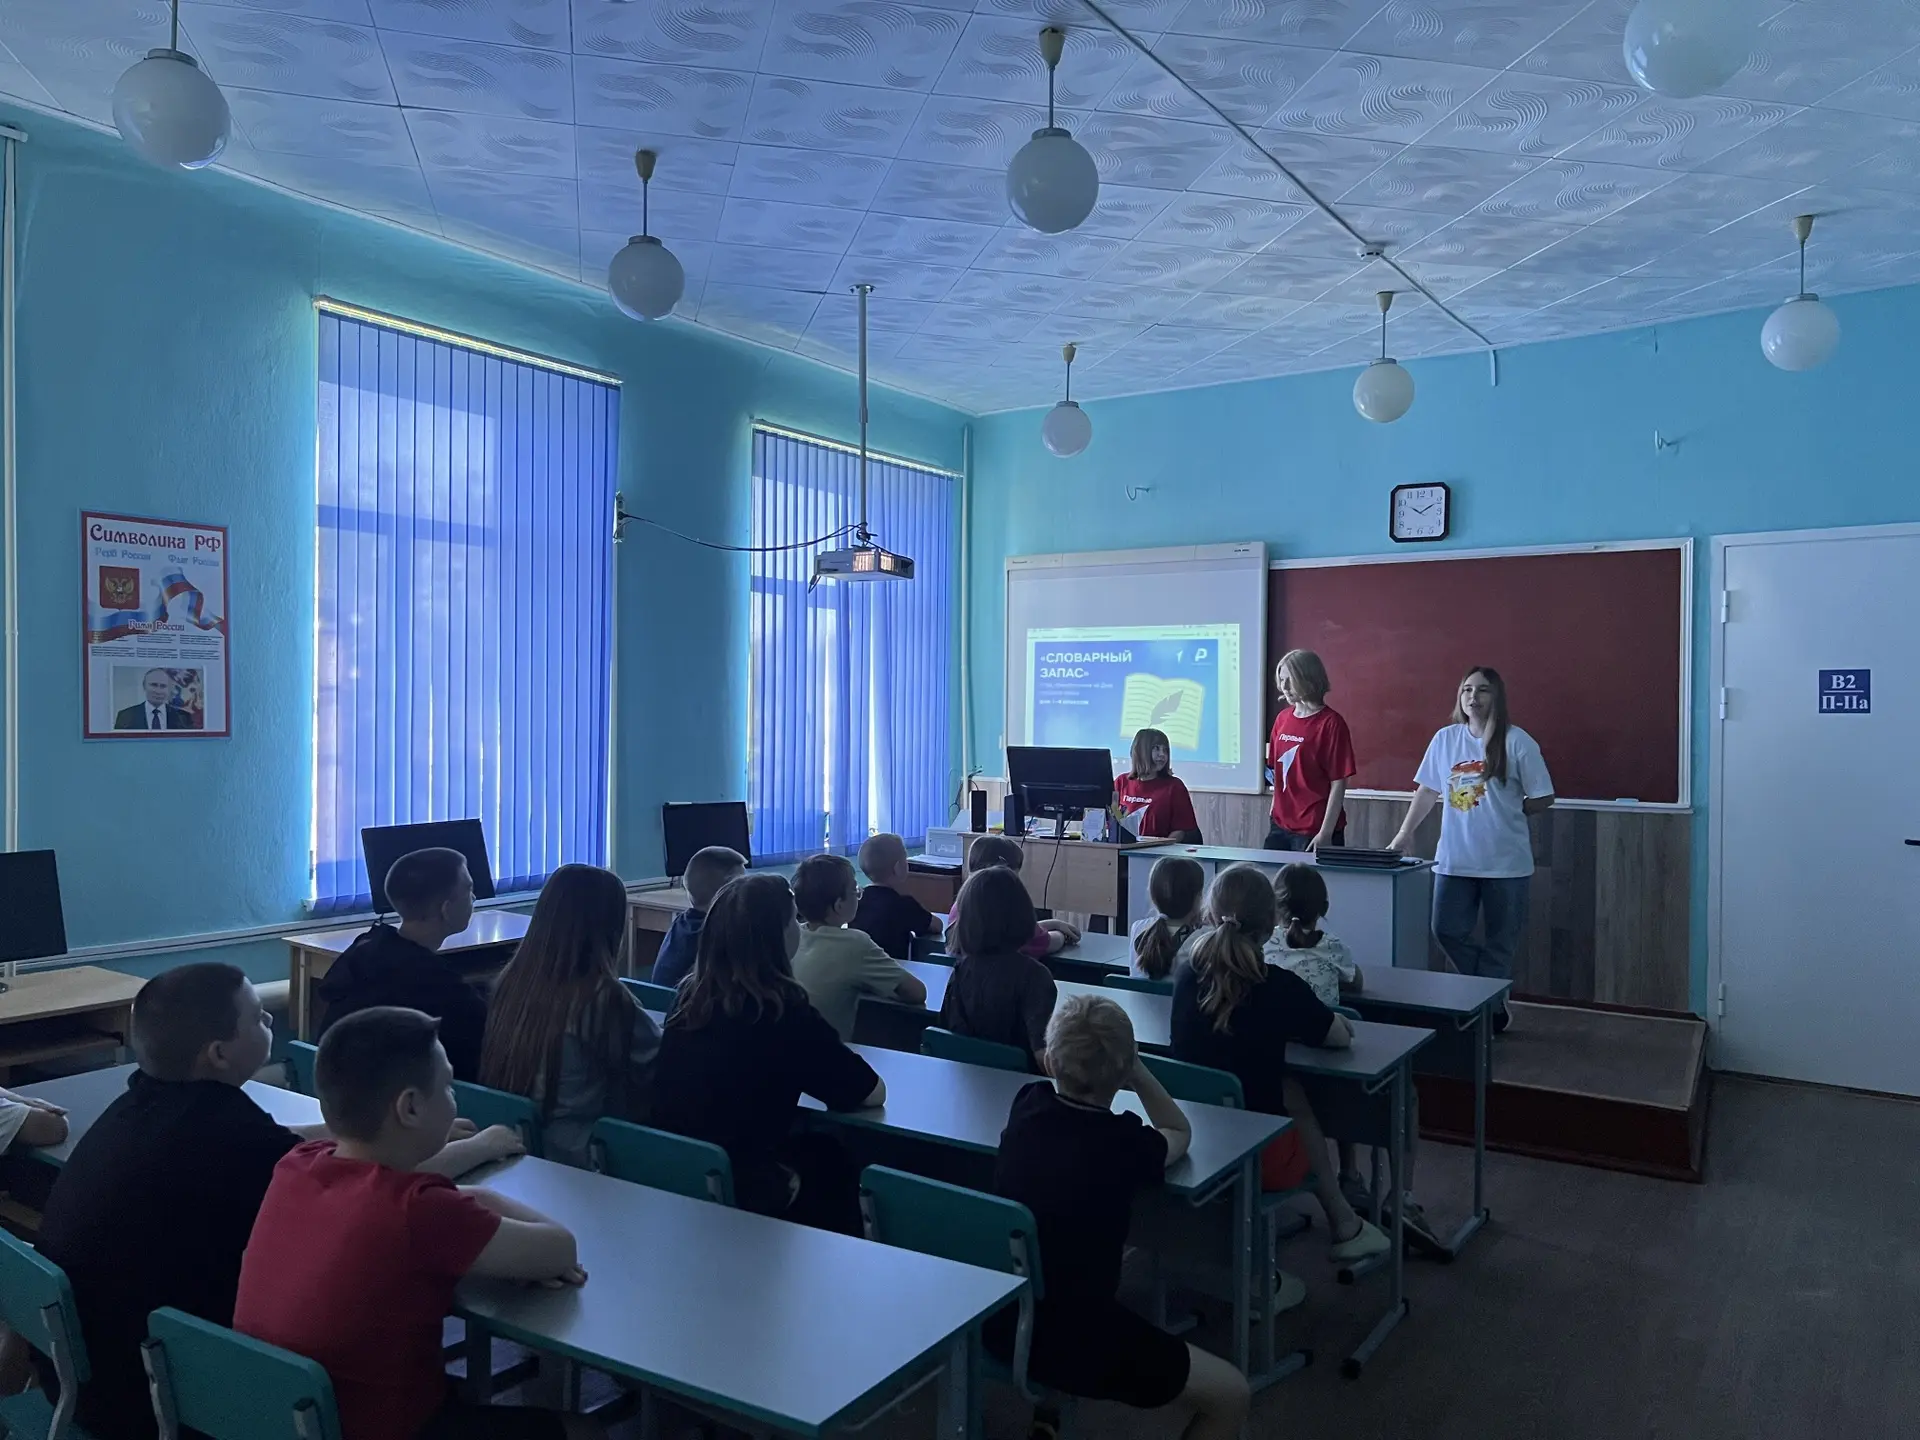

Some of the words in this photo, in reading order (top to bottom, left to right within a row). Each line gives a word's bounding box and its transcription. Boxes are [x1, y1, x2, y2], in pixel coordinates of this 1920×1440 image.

[1416, 490, 1426, 498] 12
[1430, 489, 1433, 498] 1
[1437, 496, 1443, 504] 2
[1398, 510, 1405, 518] 9
[1436, 508, 1442, 516] 3
[1406, 527, 1412, 535] 7
[1416, 527, 1424, 535] 6
[90, 524, 186, 549] Символика
[194, 534, 221, 552] РФ
[95, 547, 117, 558] Герб
[121, 549, 151, 561] России
[156, 620, 185, 632] России
[1040, 649, 1132, 663] «СЛОВАРНЫЙ
[1040, 667, 1090, 679] ЗАПАС»
[1831, 674, 1856, 689] В2
[1279, 733, 1304, 743] Первые
